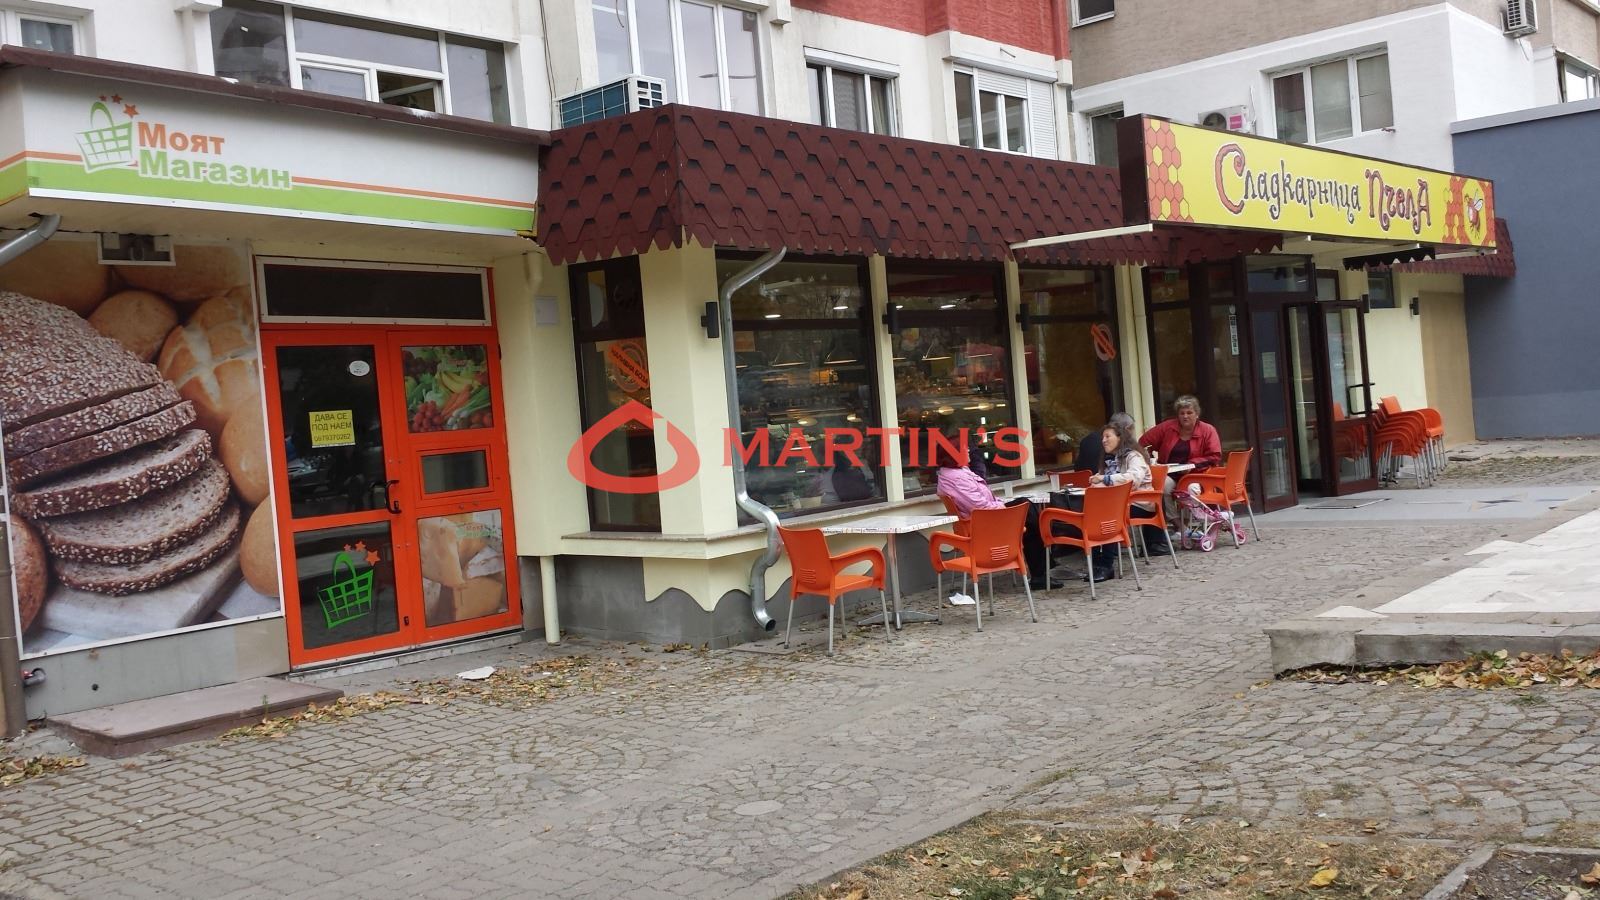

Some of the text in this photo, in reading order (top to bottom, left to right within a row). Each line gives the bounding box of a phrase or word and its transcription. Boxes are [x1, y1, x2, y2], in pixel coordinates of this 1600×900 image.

[137, 121, 225, 154] Моят
[140, 150, 290, 189] Магазин
[1215, 143, 1361, 225] Сладкарница
[312, 422, 352, 431] ПОД НАЕМ
[315, 412, 348, 422] ДАВА СЕ
